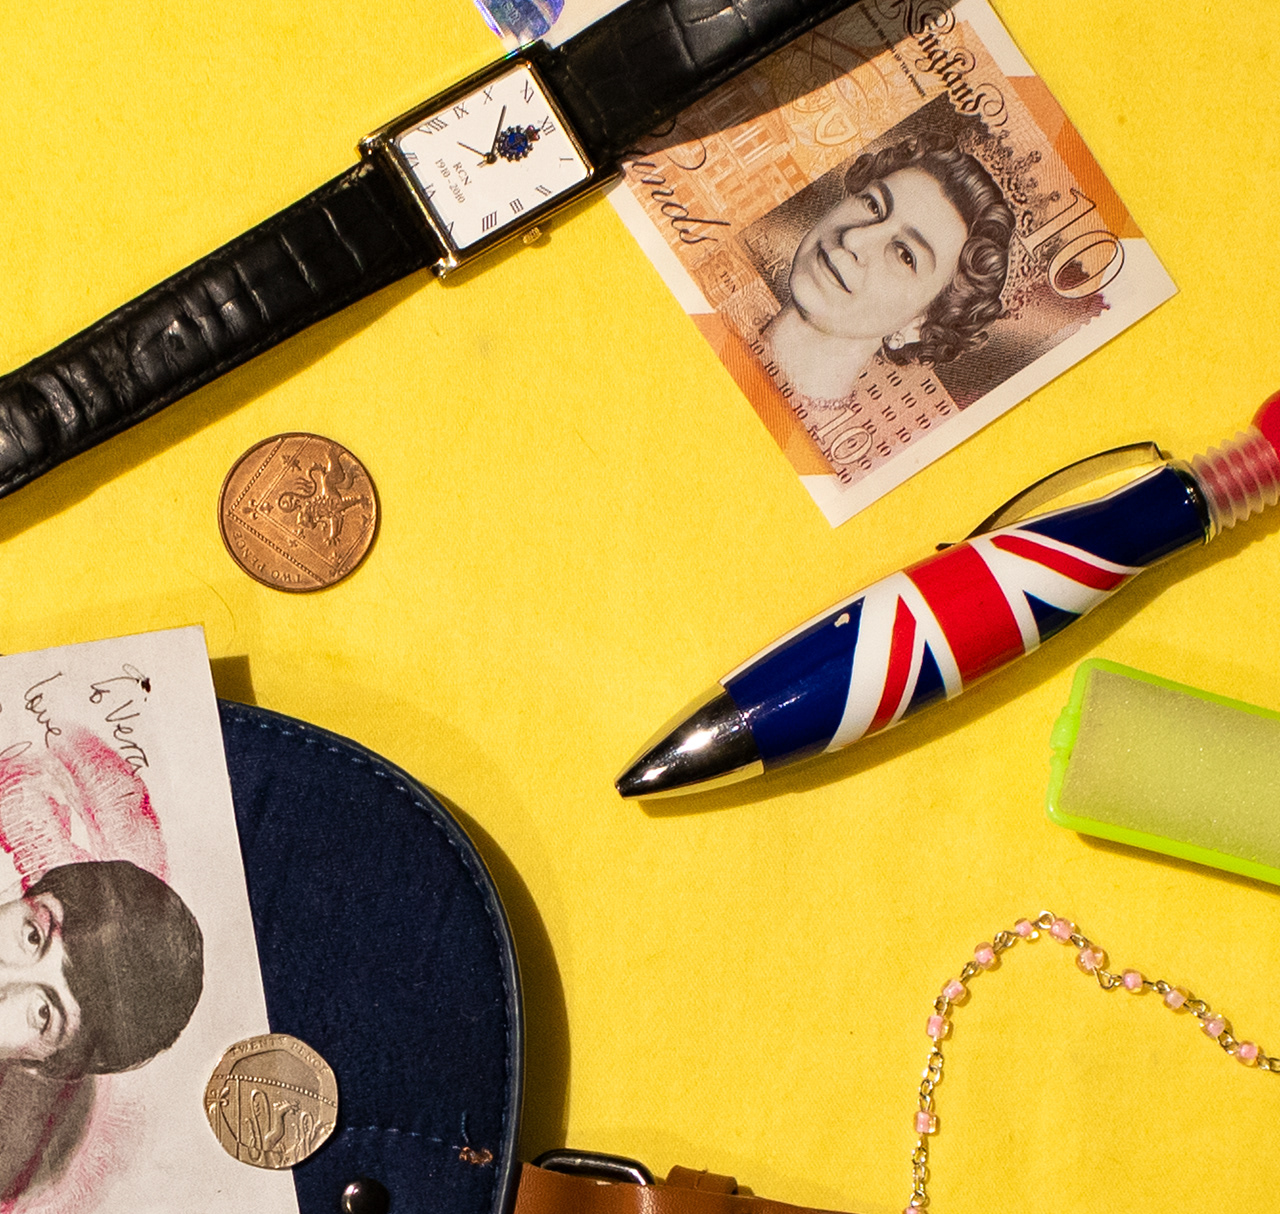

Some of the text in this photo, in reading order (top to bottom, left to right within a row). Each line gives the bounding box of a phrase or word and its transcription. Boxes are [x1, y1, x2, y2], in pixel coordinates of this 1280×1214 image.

[1012, 187, 1125, 299] 10
[764, 361, 779, 378] 10
[778, 382, 794, 399] 10
[920, 378, 937, 396] 10
[901, 392, 917, 410] 10
[935, 400, 952, 417] 10
[793, 403, 809, 420] 10
[881, 405, 897, 423] 10
[915, 413, 932, 431] 10
[817, 407, 873, 465] 10
[896, 427, 912, 444] 10
[876, 440, 892, 457] 10
[837, 468, 852, 484] 10
[233, 530, 303, 584] TWO PENCE
[105, 699, 149, 777] Vera
[230, 1037, 330, 1074] TWENTY PENCE
